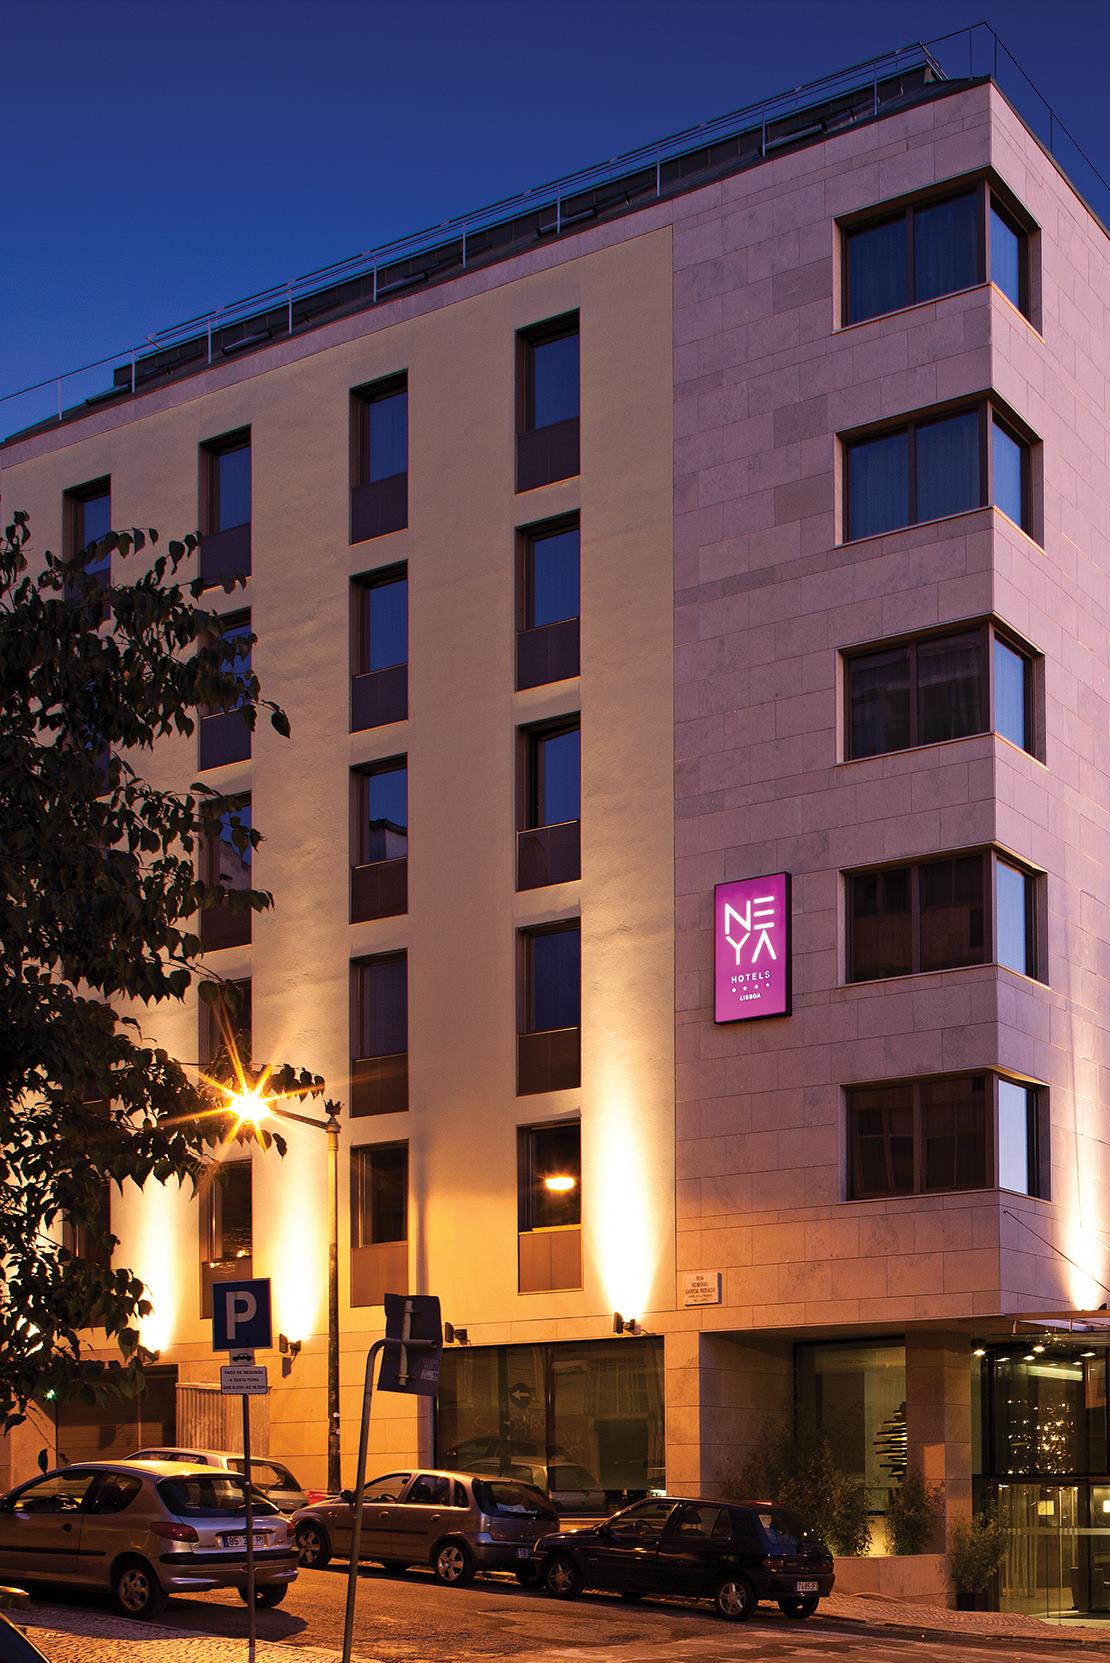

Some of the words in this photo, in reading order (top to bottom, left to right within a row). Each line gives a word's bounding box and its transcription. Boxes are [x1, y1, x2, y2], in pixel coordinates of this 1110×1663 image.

[731, 970, 770, 984] HOTELS
[739, 993, 761, 1001] LISBOA
[225, 1290, 257, 1340] P
